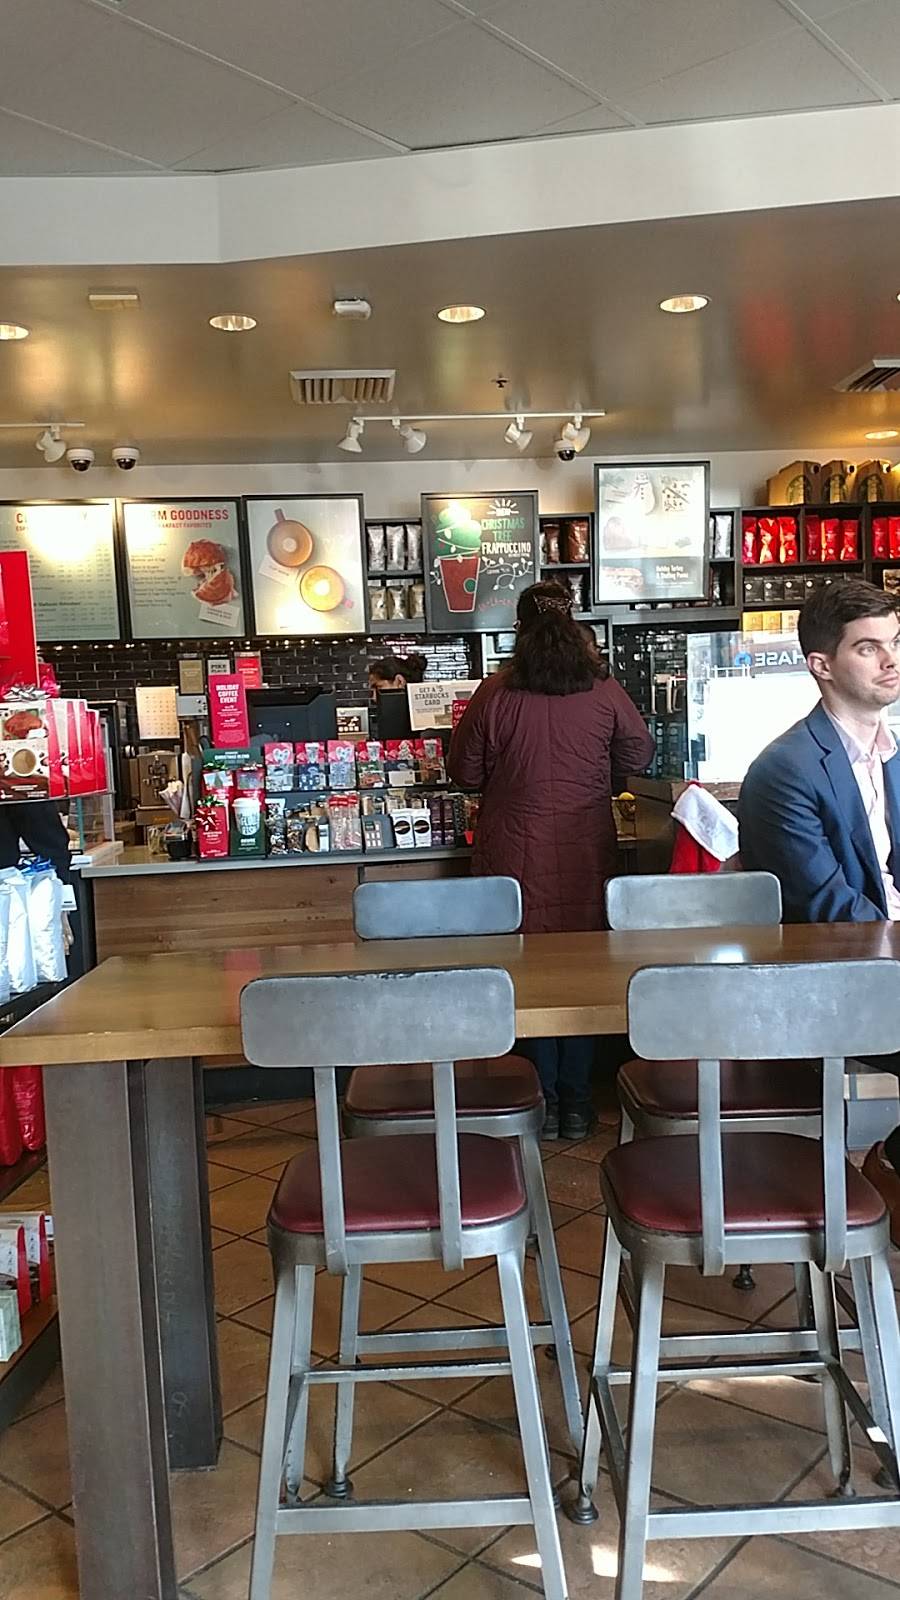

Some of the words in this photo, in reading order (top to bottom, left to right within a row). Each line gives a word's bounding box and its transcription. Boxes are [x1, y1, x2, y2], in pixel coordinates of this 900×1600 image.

[170, 509, 229, 520] GOODNESS
[481, 518, 525, 530] CHRISTMAS
[493, 530, 512, 541] TREE
[482, 542, 531, 554] FRAPPUCCINO
